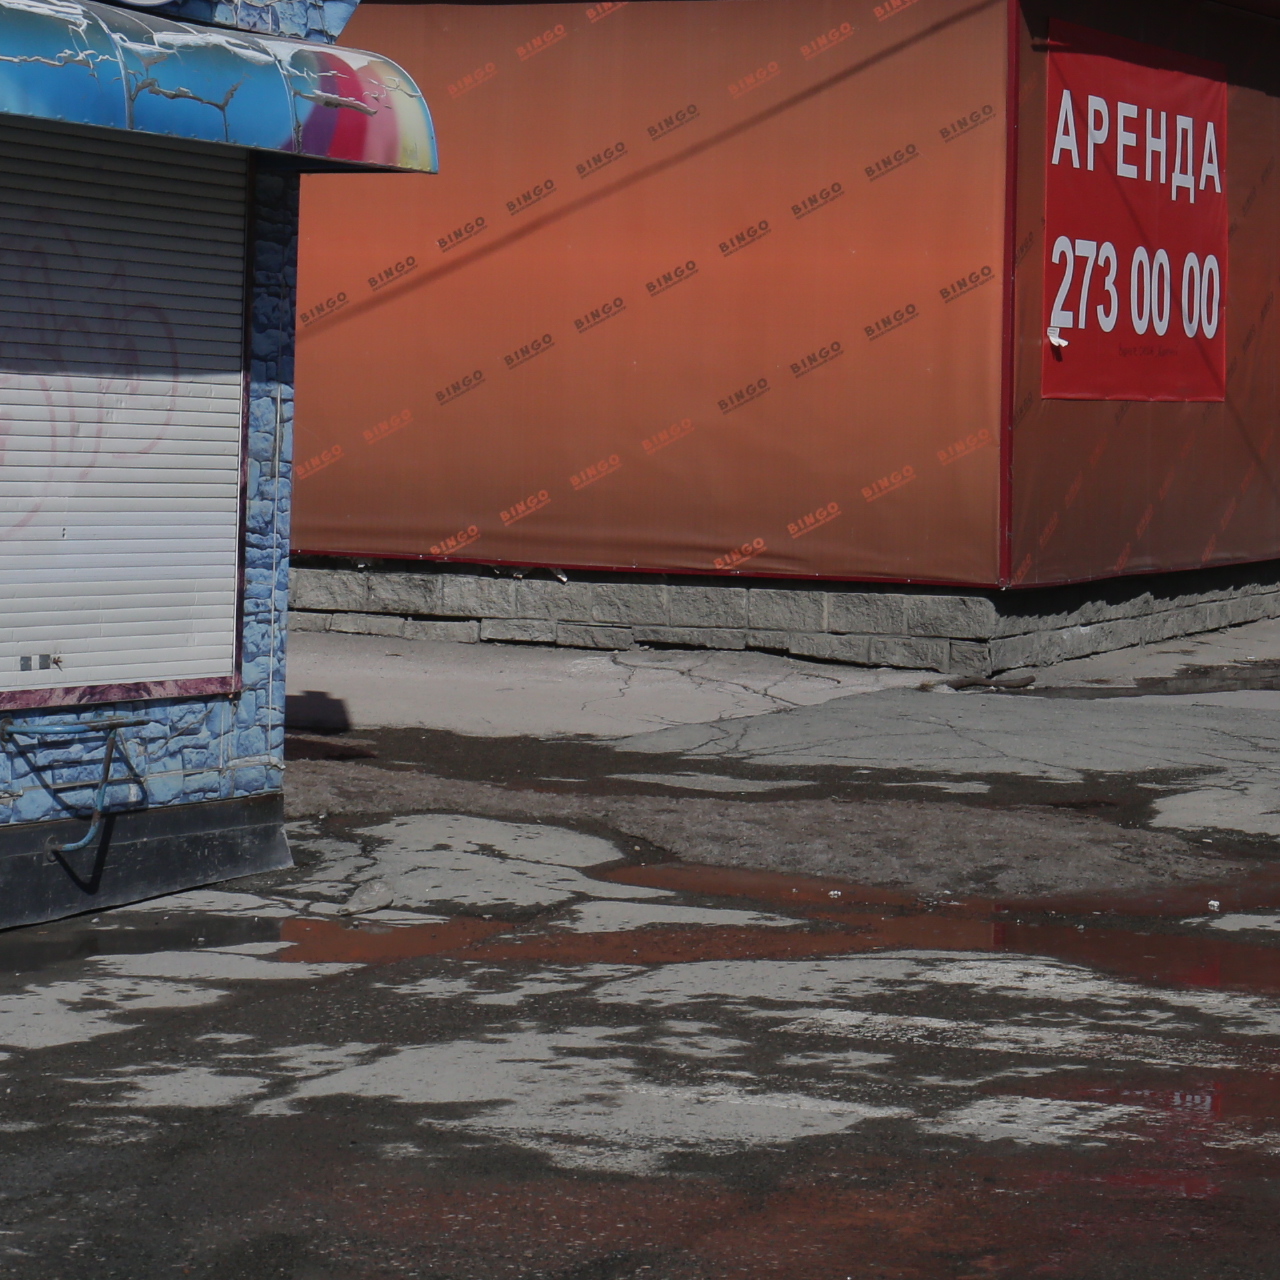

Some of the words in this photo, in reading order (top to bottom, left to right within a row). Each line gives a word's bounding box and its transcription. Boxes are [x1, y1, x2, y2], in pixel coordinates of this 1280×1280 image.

[516, 24, 565, 57] BINGO
[800, 22, 852, 56] BINGO
[448, 62, 496, 94] BINGO
[727, 61, 779, 95] BINGO
[647, 104, 699, 138] BINGO
[939, 105, 993, 139] BINGO
[575, 142, 626, 177] BINGO
[866, 144, 919, 178] BINGO
[1051, 89, 1222, 204] АРЕНДА
[506, 179, 556, 214] BINGO
[792, 182, 844, 216] BINGO
[437, 216, 486, 249] BINGO
[719, 220, 769, 253] BINGO
[368, 256, 416, 288] BINGO
[646, 259, 696, 292] BINGO
[939, 265, 993, 301] BINGO
[1050, 235, 1118, 333] 273
[1130, 245, 1171, 337] 00
[1181, 251, 1220, 340] 00
[300, 292, 347, 324] BINGO
[573, 297, 623, 330] BINGO
[864, 303, 917, 339] BINGO
[504, 333, 552, 366] BINGO
[791, 340, 842, 374] BINGO
[435, 370, 483, 402] BINGO
[718, 378, 768, 411] BINGO
[363, 409, 411, 441] BINGO
[642, 418, 693, 453] BINGO
[296, 444, 342, 476] BINGO
[937, 429, 990, 461] BINGO
[570, 454, 621, 488] BINGO
[861, 465, 914, 499] BINGO
[500, 490, 549, 521] BINGO
[787, 502, 839, 535] BINGO
[430, 525, 478, 555] BINGO
[713, 537, 765, 568] BINGO
